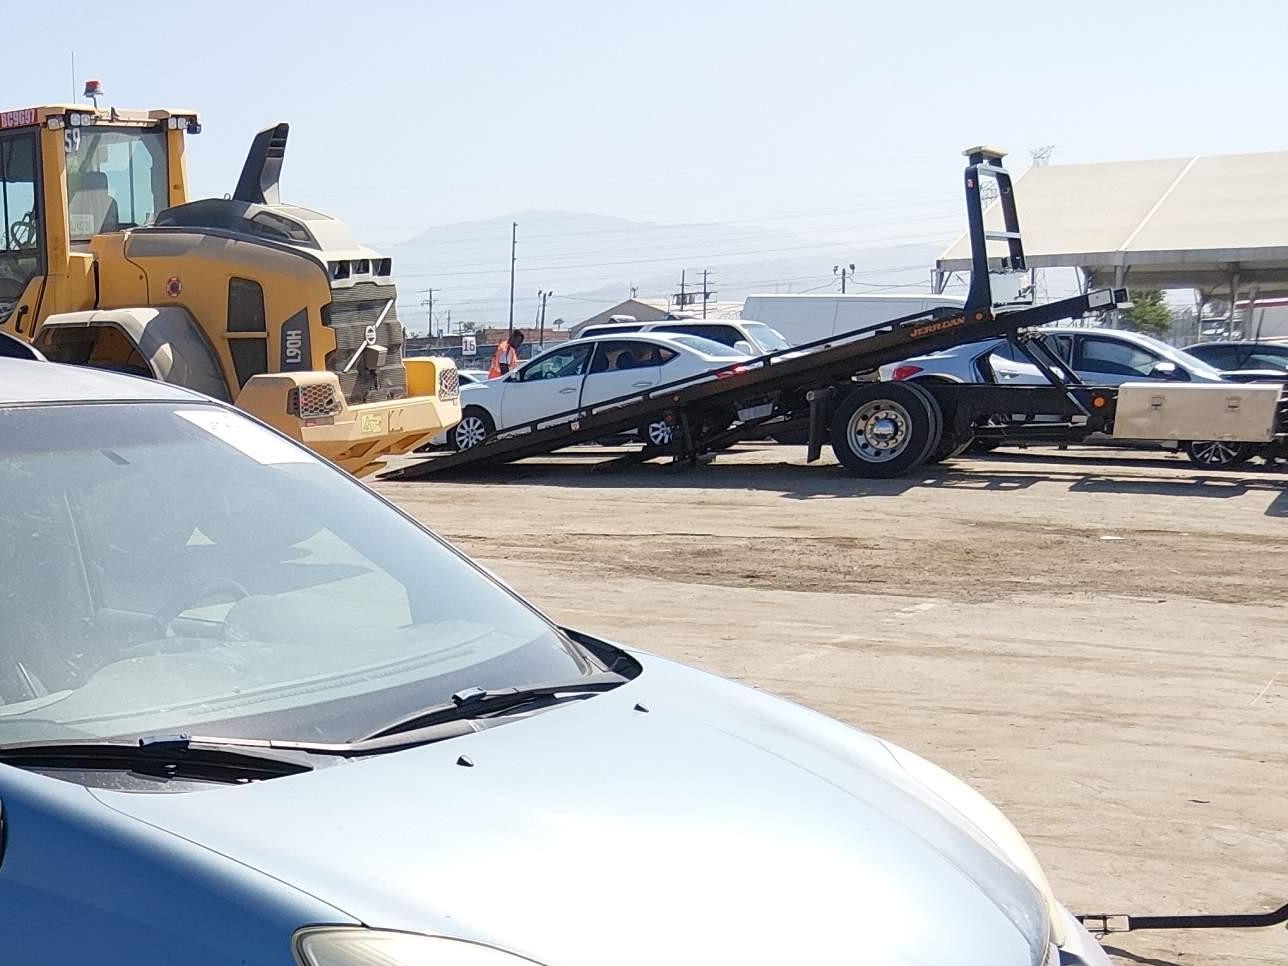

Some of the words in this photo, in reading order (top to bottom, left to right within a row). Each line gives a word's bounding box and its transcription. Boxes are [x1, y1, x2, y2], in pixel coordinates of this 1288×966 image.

[64, 128, 81, 152] 59
[286, 330, 302, 363] L90H
[463, 340, 476, 352] 16
